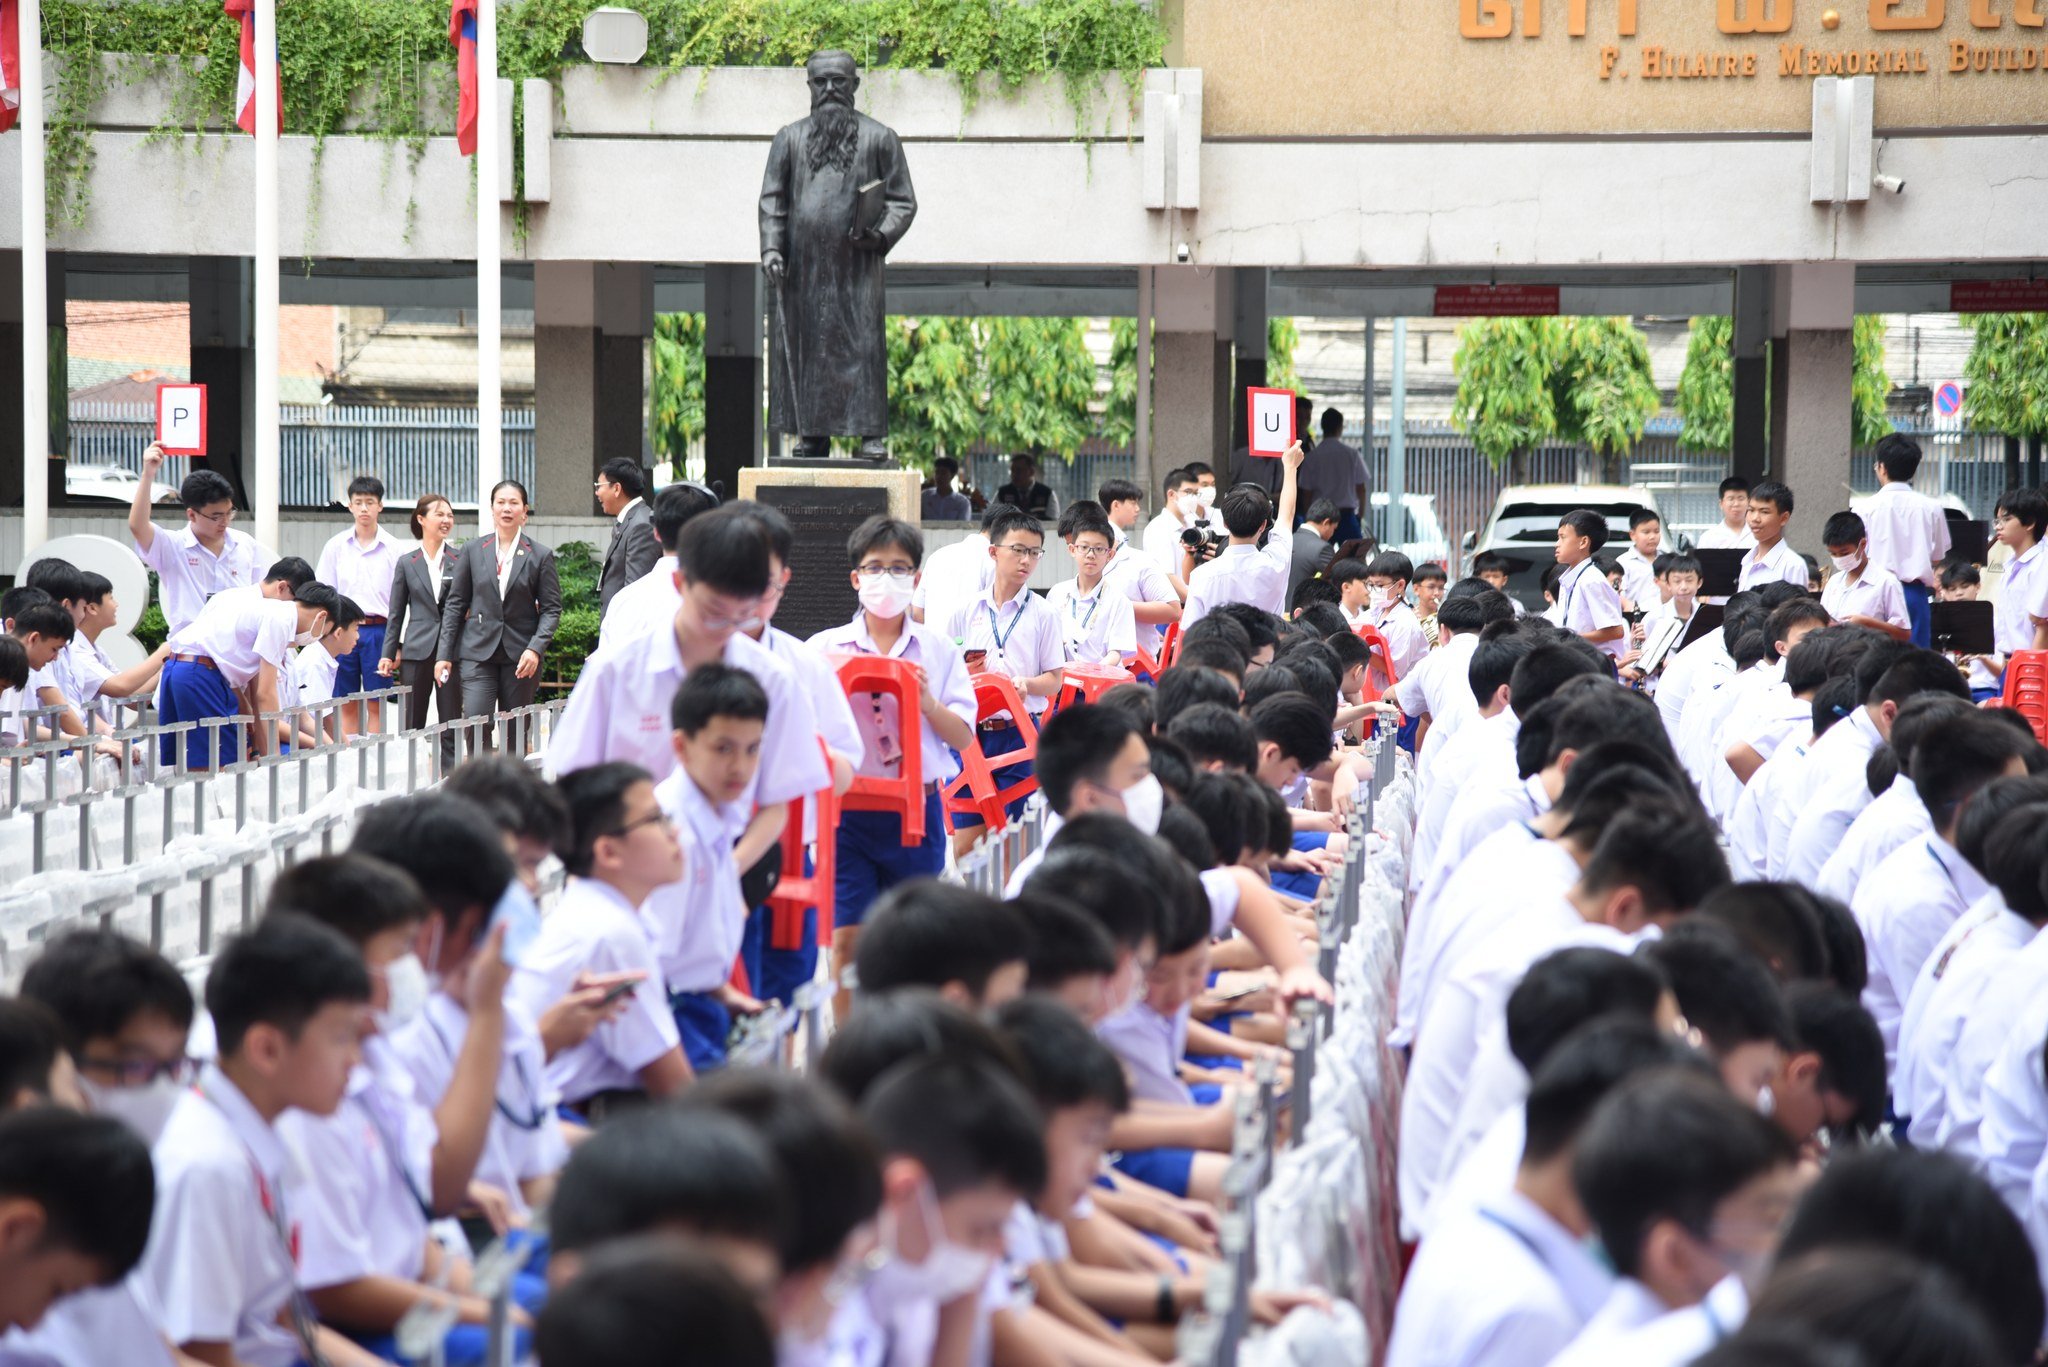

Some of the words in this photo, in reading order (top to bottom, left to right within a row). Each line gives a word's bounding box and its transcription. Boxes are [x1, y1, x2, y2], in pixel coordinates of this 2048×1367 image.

[1600, 46, 1628, 79] F.
[1641, 46, 1757, 78] HILAIRE
[1779, 43, 1928, 76] MEMORIAL
[174, 407, 189, 428] P
[1264, 412, 1280, 433] U
